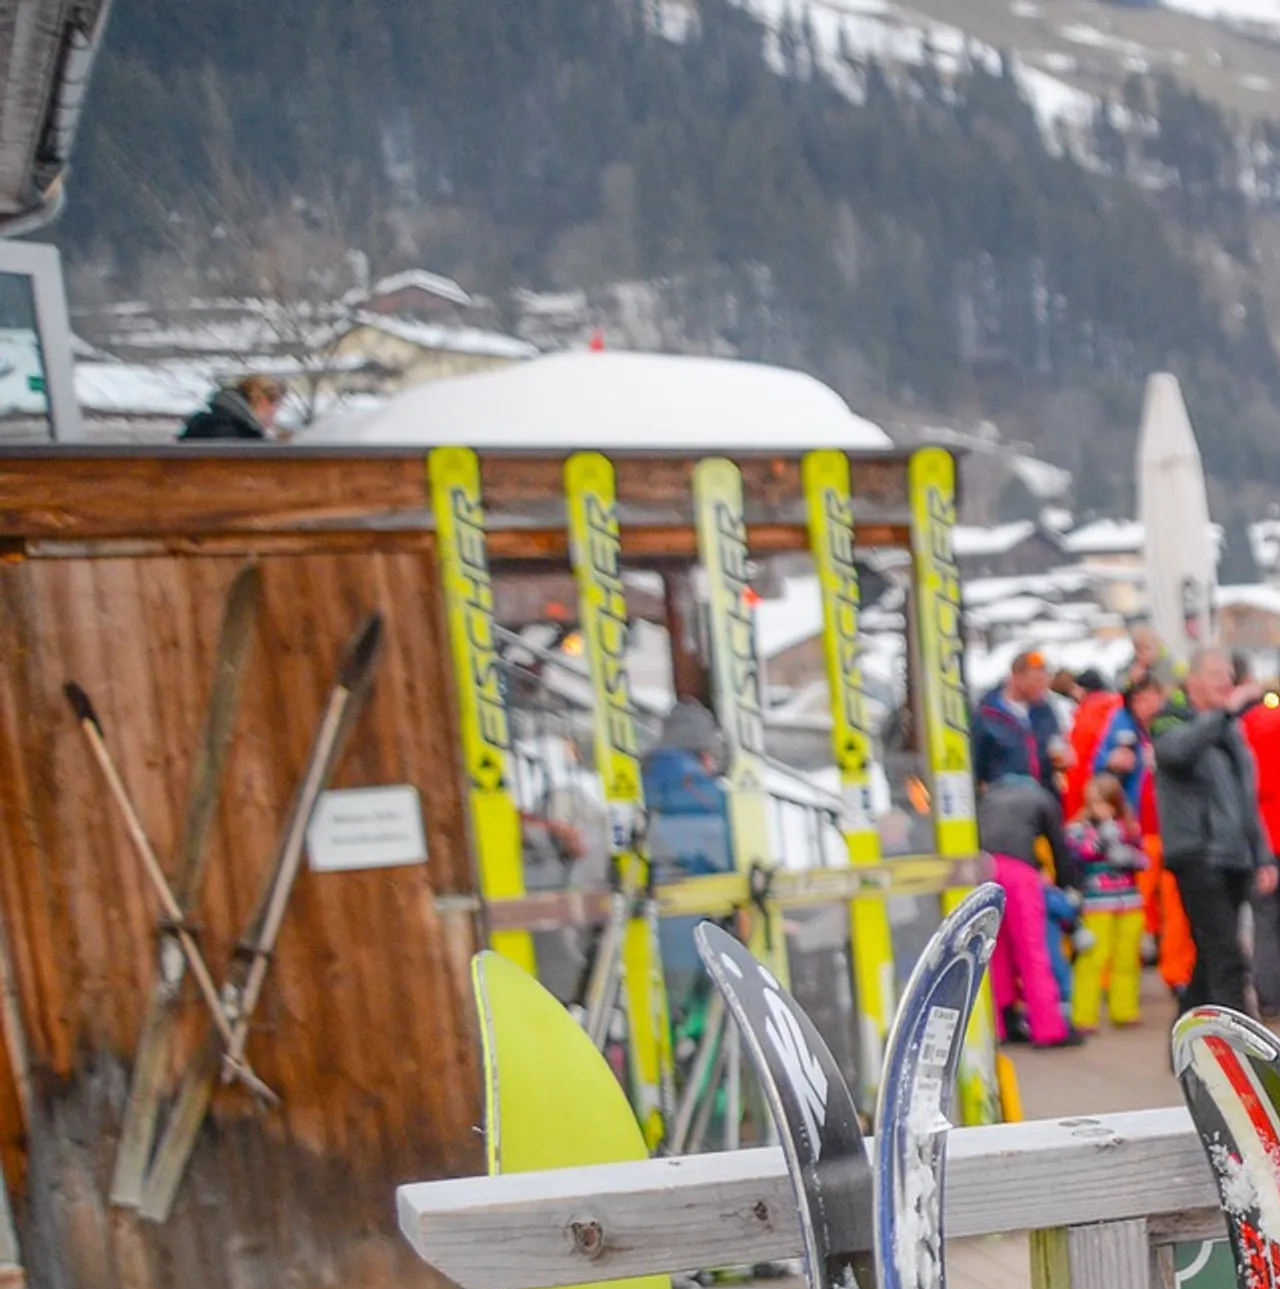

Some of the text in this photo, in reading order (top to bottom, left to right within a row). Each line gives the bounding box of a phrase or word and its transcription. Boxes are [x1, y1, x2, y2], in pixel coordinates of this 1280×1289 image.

[452, 488, 510, 748] FISCHER
[585, 493, 640, 760] FISCHER
[715, 500, 763, 758] FISCHER
[826, 488, 869, 732] FISCHER
[927, 486, 970, 735] FISCHER
